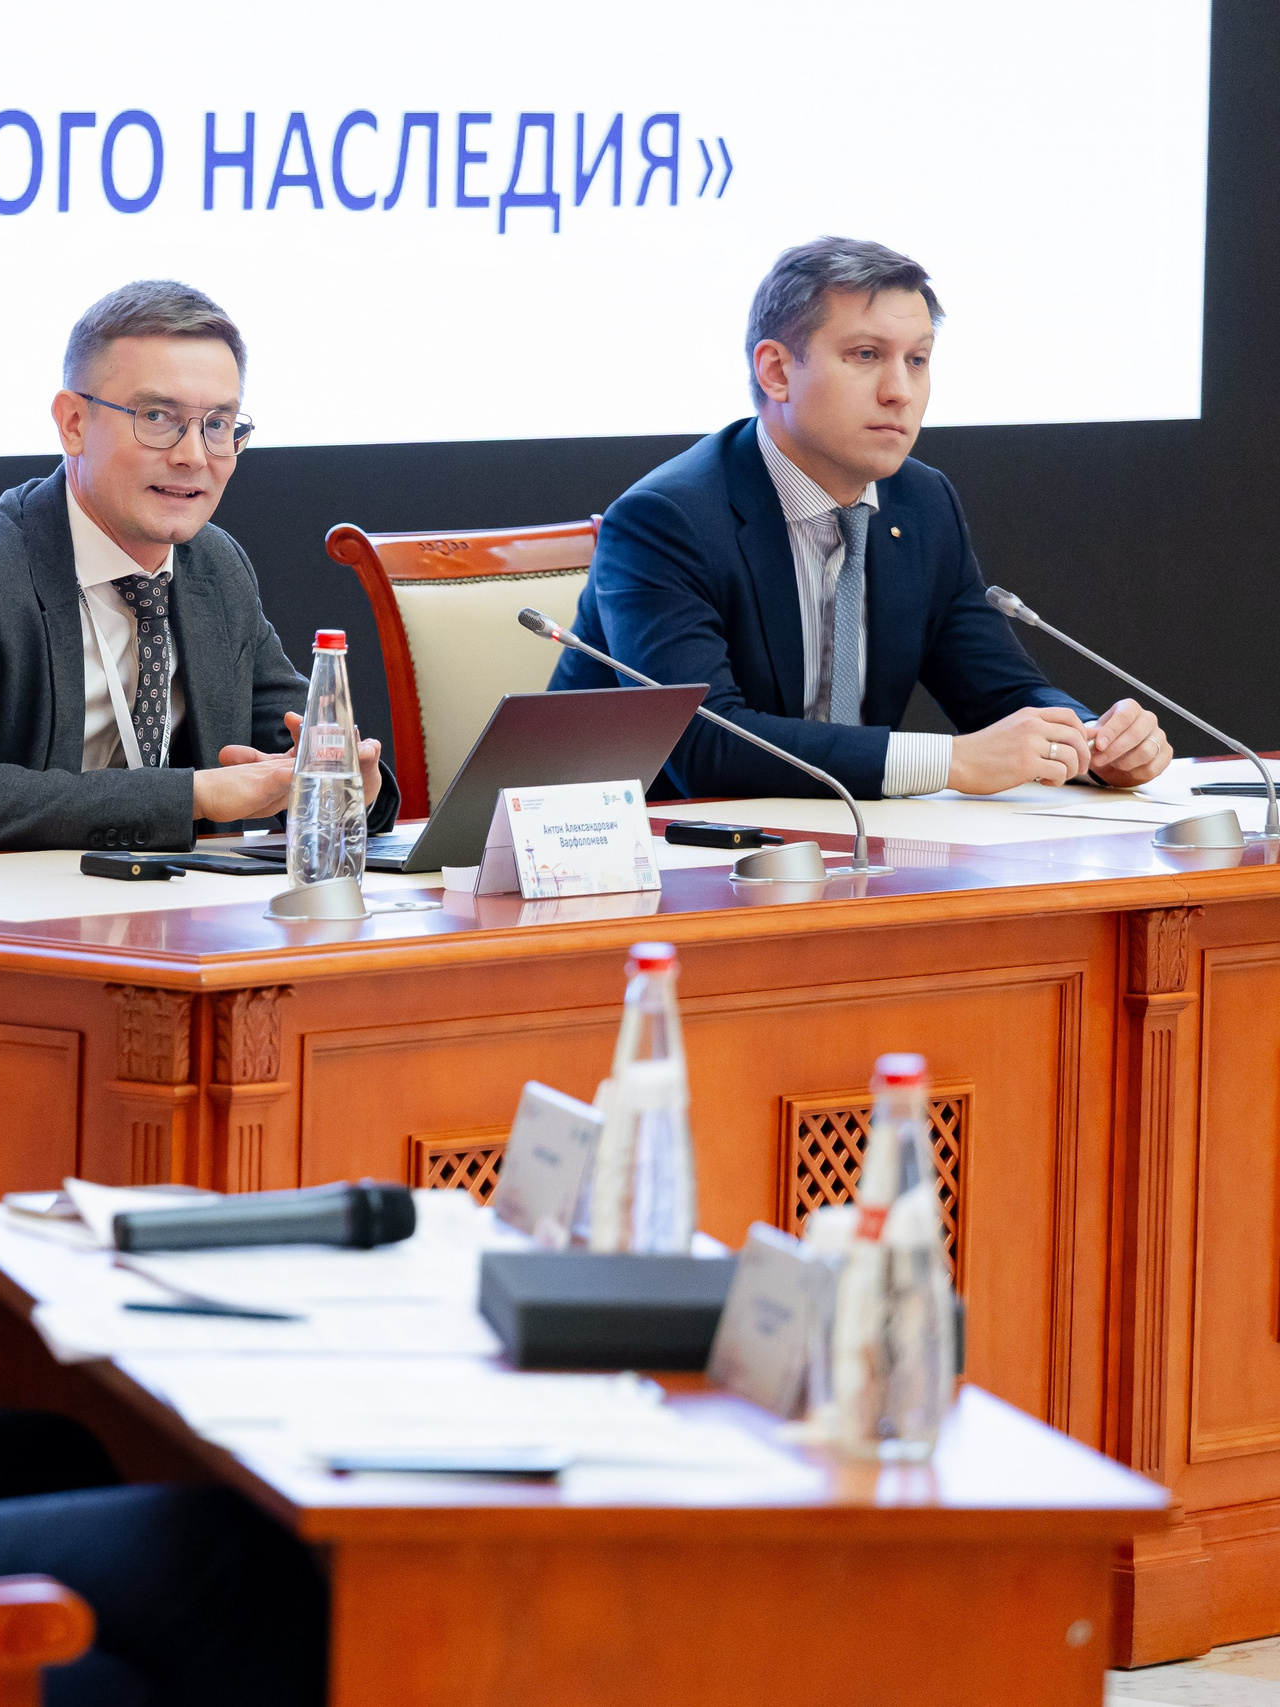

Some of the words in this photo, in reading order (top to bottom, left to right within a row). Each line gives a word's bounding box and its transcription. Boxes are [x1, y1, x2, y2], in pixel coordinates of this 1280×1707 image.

[202, 111, 734, 234] НАСЛЕДИЯ»
[543, 824, 564, 834] Антон
[565, 821, 618, 833] Александрович
[559, 836, 608, 849] Варфоломеев
